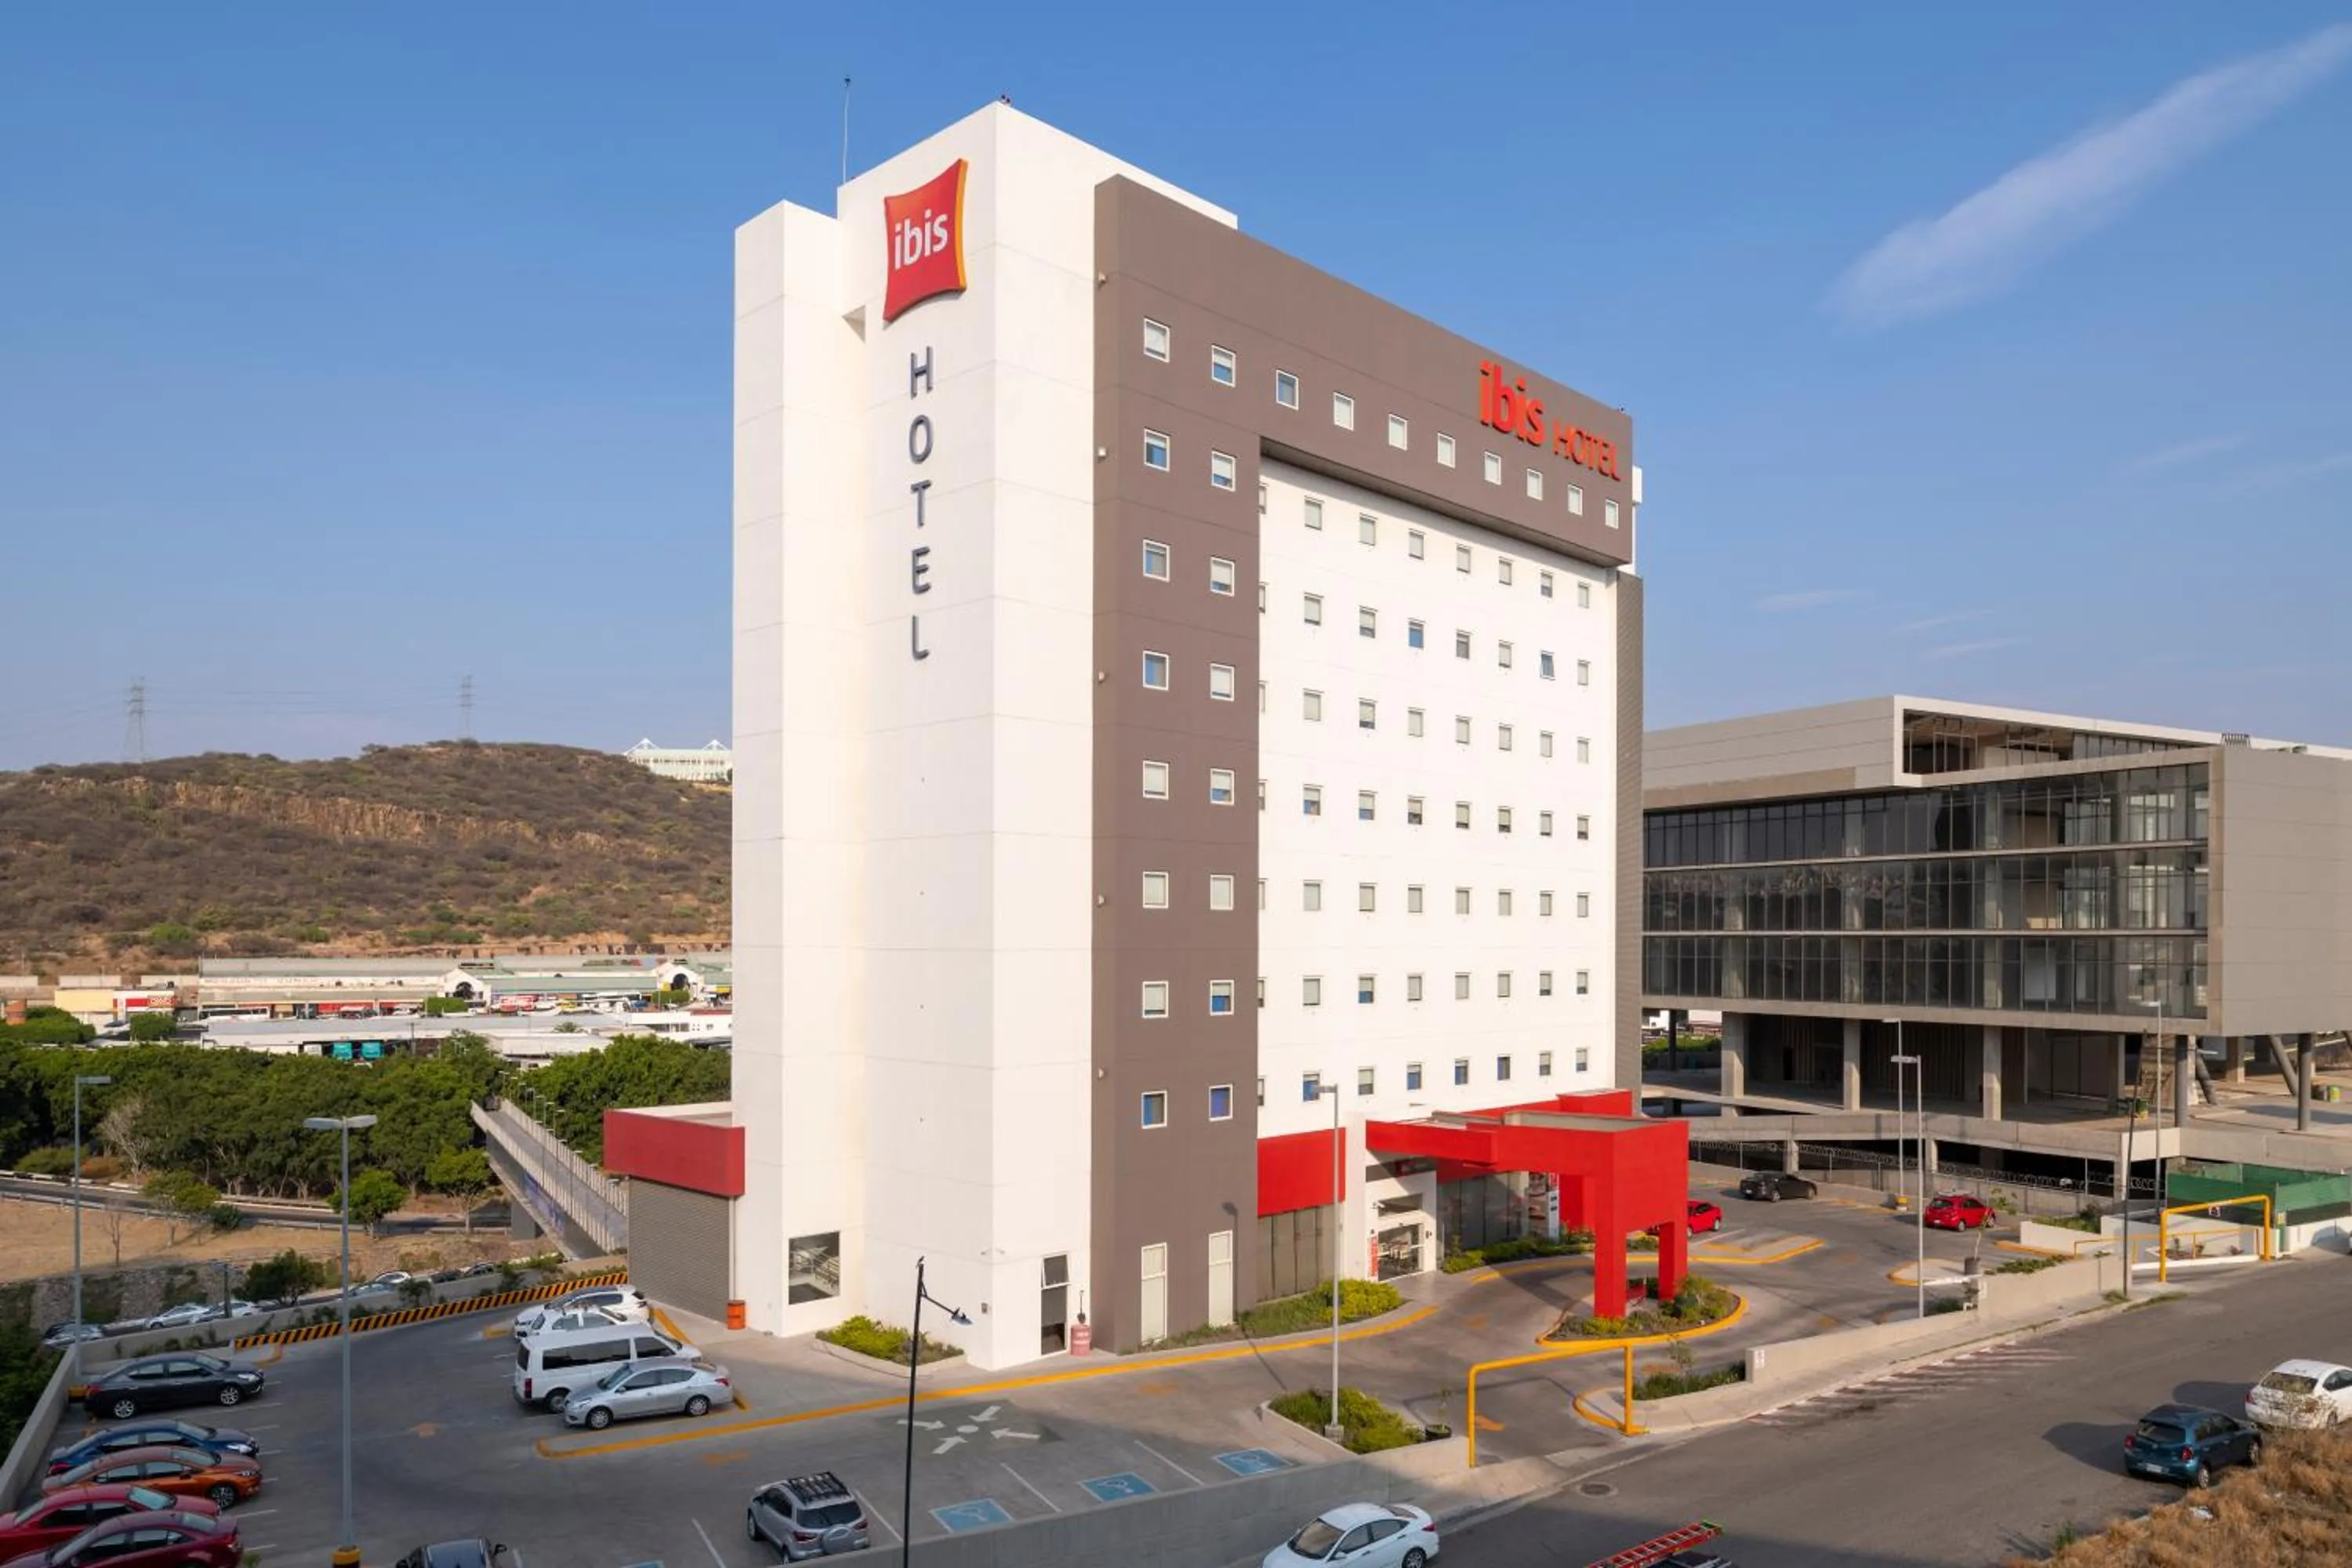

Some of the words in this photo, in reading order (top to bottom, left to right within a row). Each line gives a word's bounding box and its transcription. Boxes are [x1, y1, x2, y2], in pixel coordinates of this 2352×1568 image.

[895, 209, 948, 270] ibis
[1481, 361, 1545, 446] ibis
[1553, 420, 1620, 481] HOTEL
[909, 346, 934, 659] HOTEL
